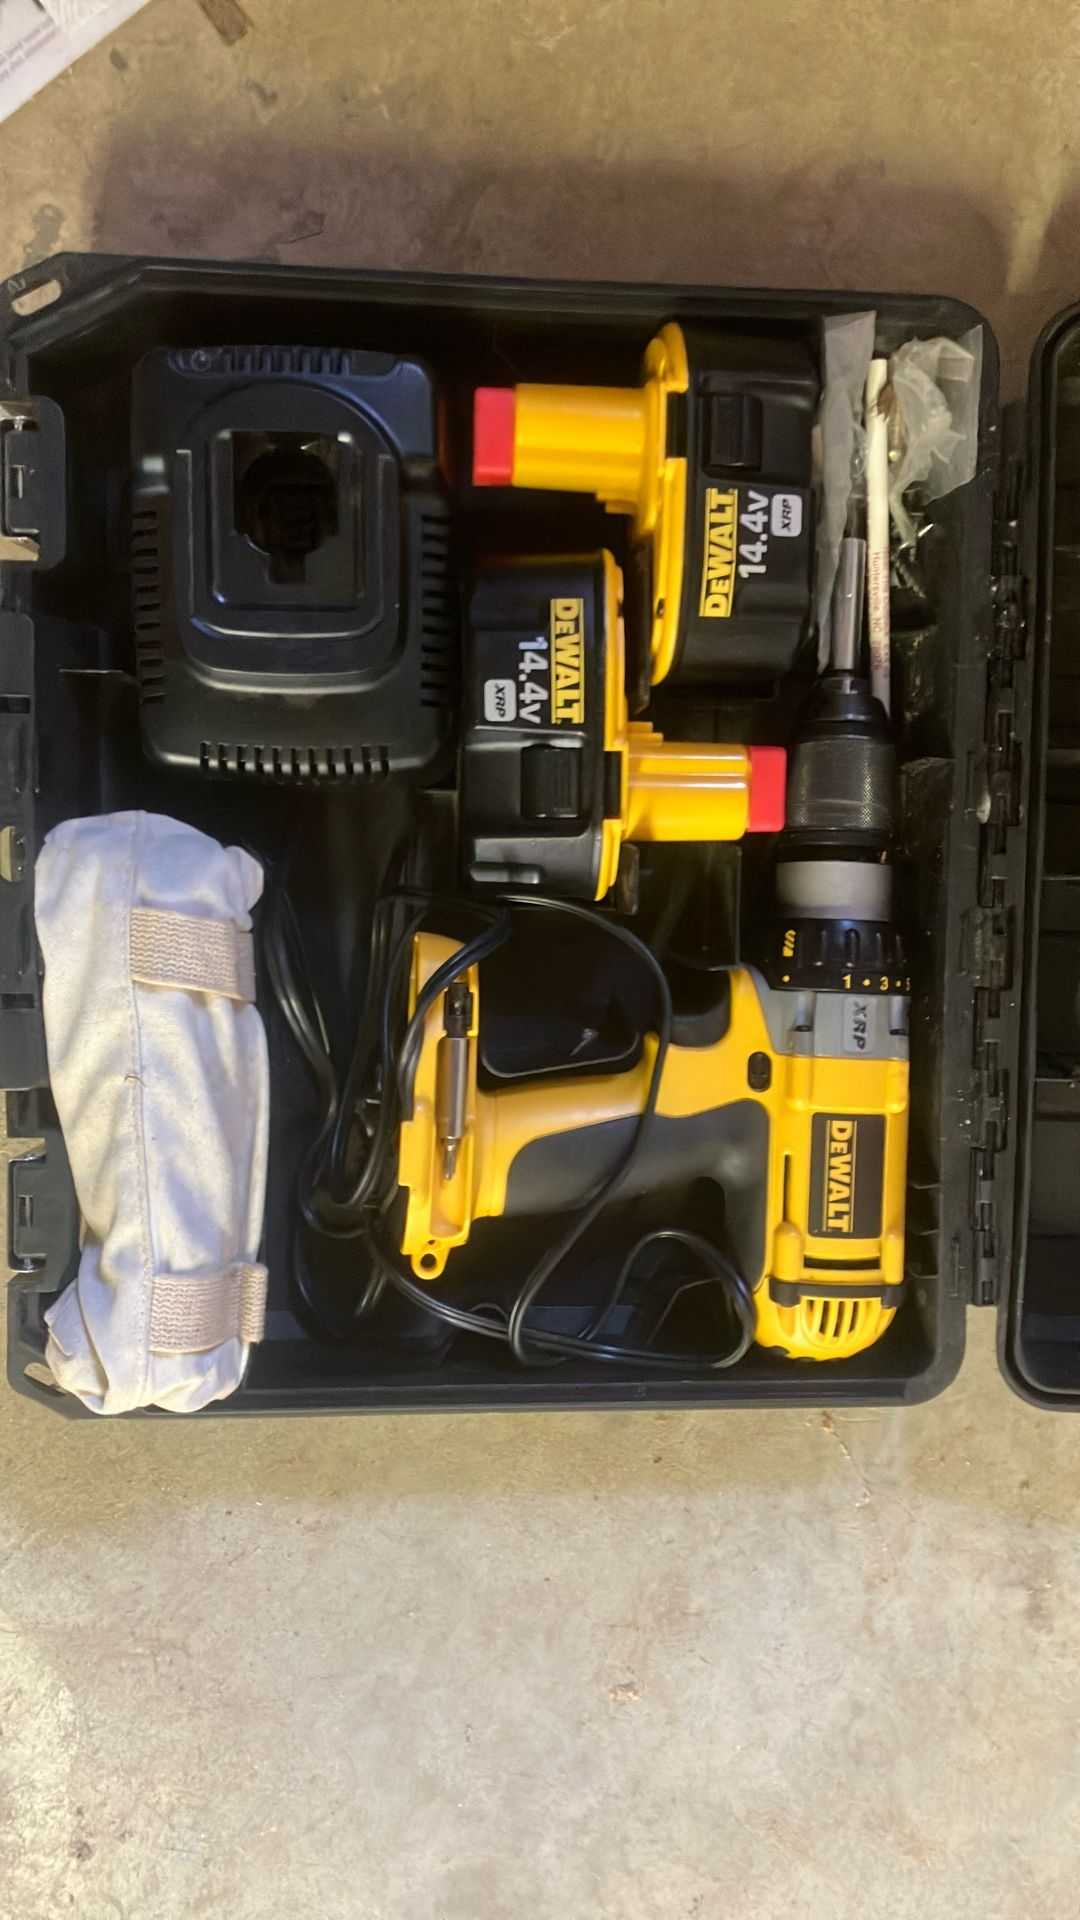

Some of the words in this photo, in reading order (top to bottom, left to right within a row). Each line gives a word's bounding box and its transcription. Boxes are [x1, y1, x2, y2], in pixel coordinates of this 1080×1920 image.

[780, 498, 792, 532] XRP
[703, 488, 736, 617] DEWALT
[554, 599, 582, 724] DEWALT
[494, 683, 506, 718] XRP
[842, 973, 852, 990] 1
[879, 975, 889, 991] 3
[853, 1001, 868, 1050] XRP
[827, 1119, 853, 1233] DEWALT
